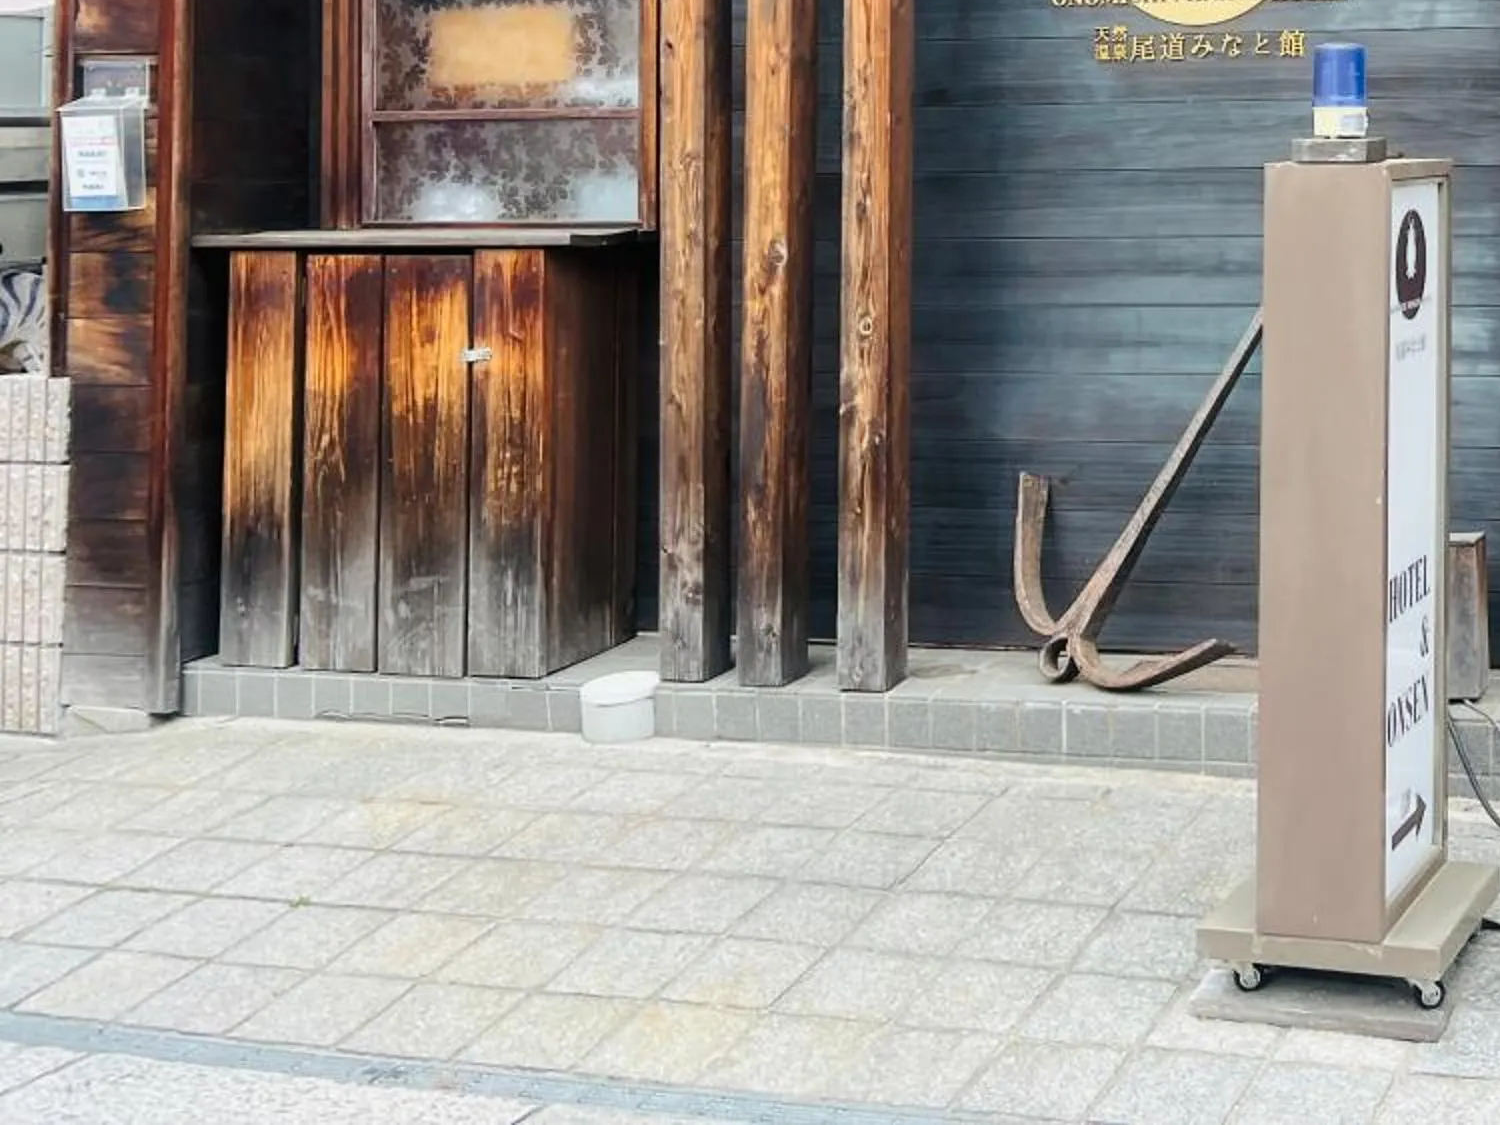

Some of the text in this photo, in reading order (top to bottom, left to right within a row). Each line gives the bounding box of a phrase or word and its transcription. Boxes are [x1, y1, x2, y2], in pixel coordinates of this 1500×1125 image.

[1389, 555, 1431, 624] HOTEL
[1419, 615, 1430, 658] &
[1387, 674, 1430, 748] ONSEN
